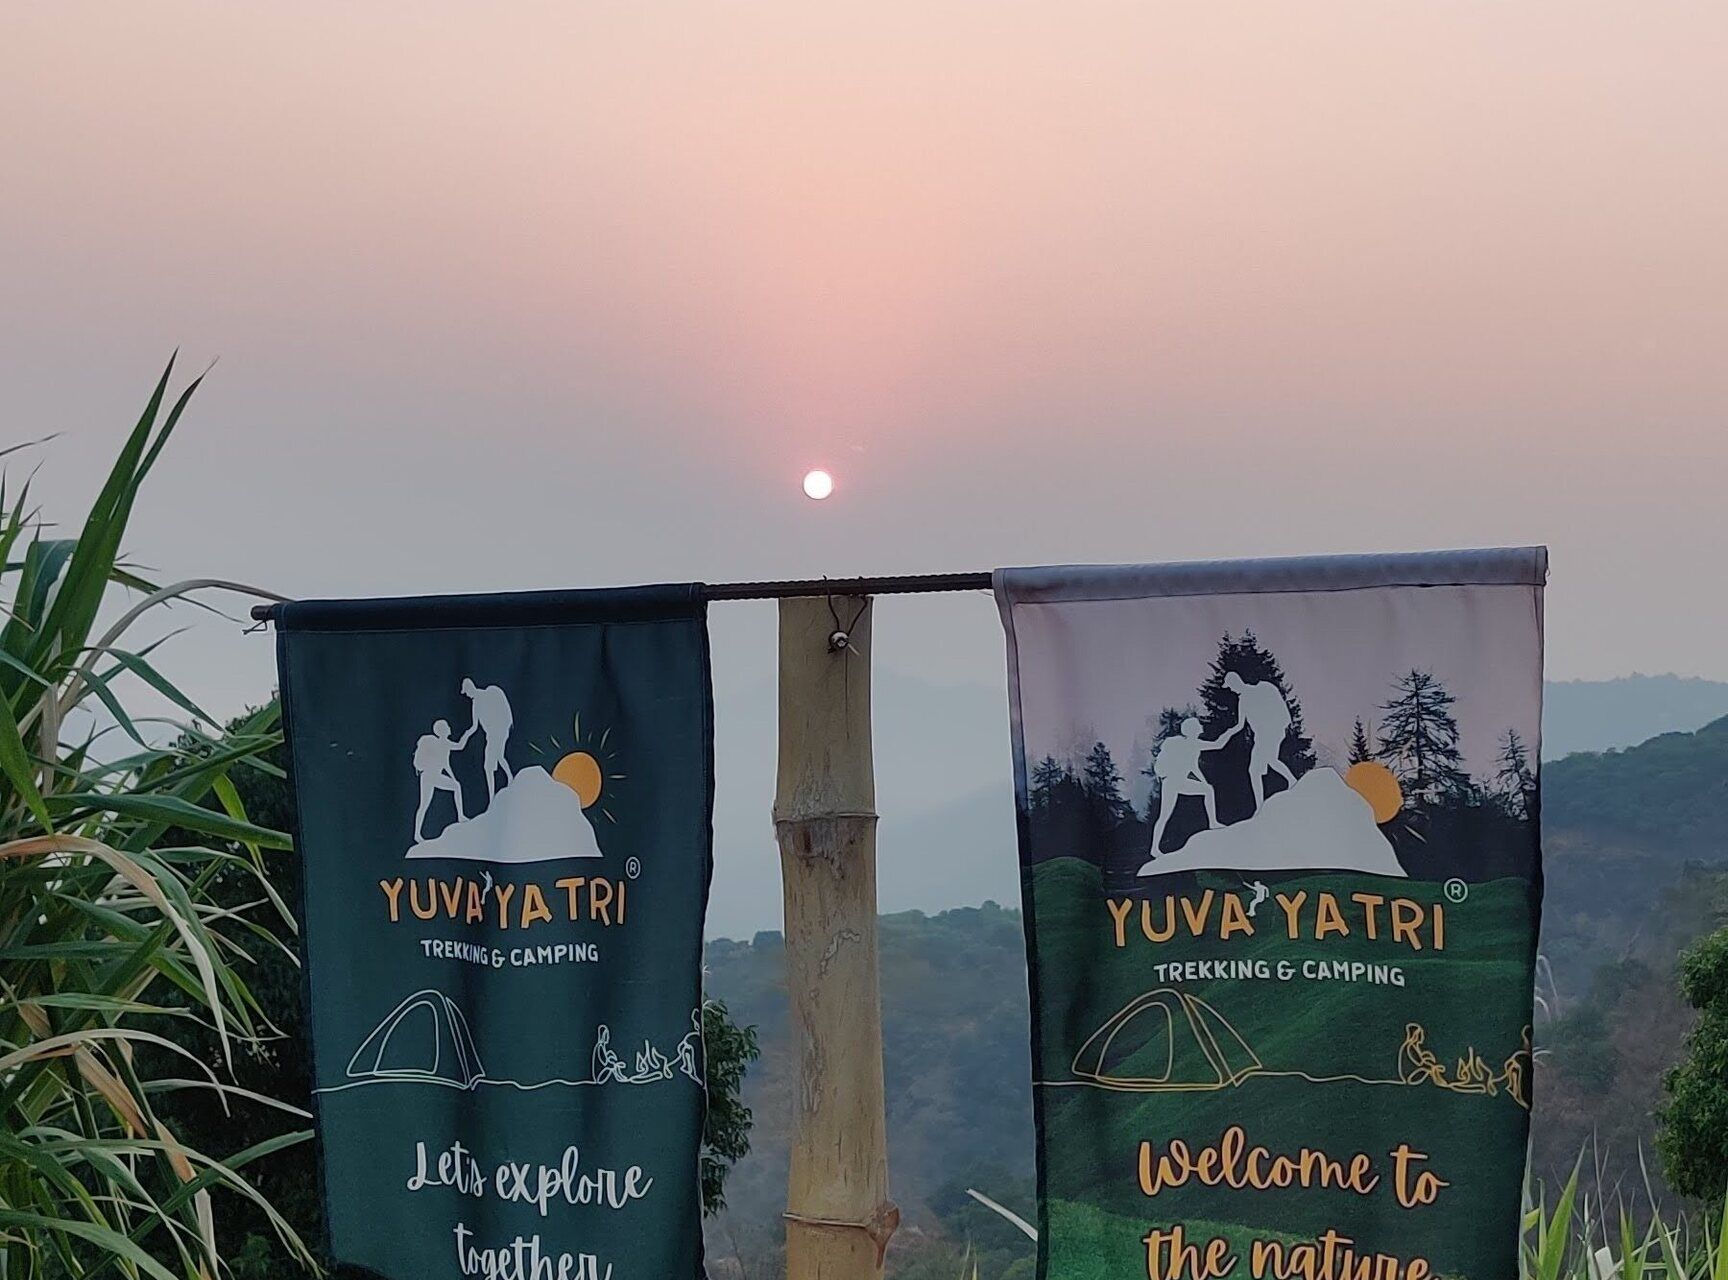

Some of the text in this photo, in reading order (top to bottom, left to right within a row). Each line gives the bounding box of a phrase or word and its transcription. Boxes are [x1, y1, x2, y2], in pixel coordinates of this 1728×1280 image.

[379, 876, 484, 925] YUVA
[494, 877, 625, 929] YATRI
[1106, 889, 1255, 948] YUVA
[1275, 889, 1444, 951] YATRI
[420, 939, 599, 968] TREKKING & CAMPING
[1153, 959, 1405, 987] TREKKING & CAMPING
[407, 1140, 653, 1216] Let's explore
[1138, 1126, 1450, 1208] Welcome to
